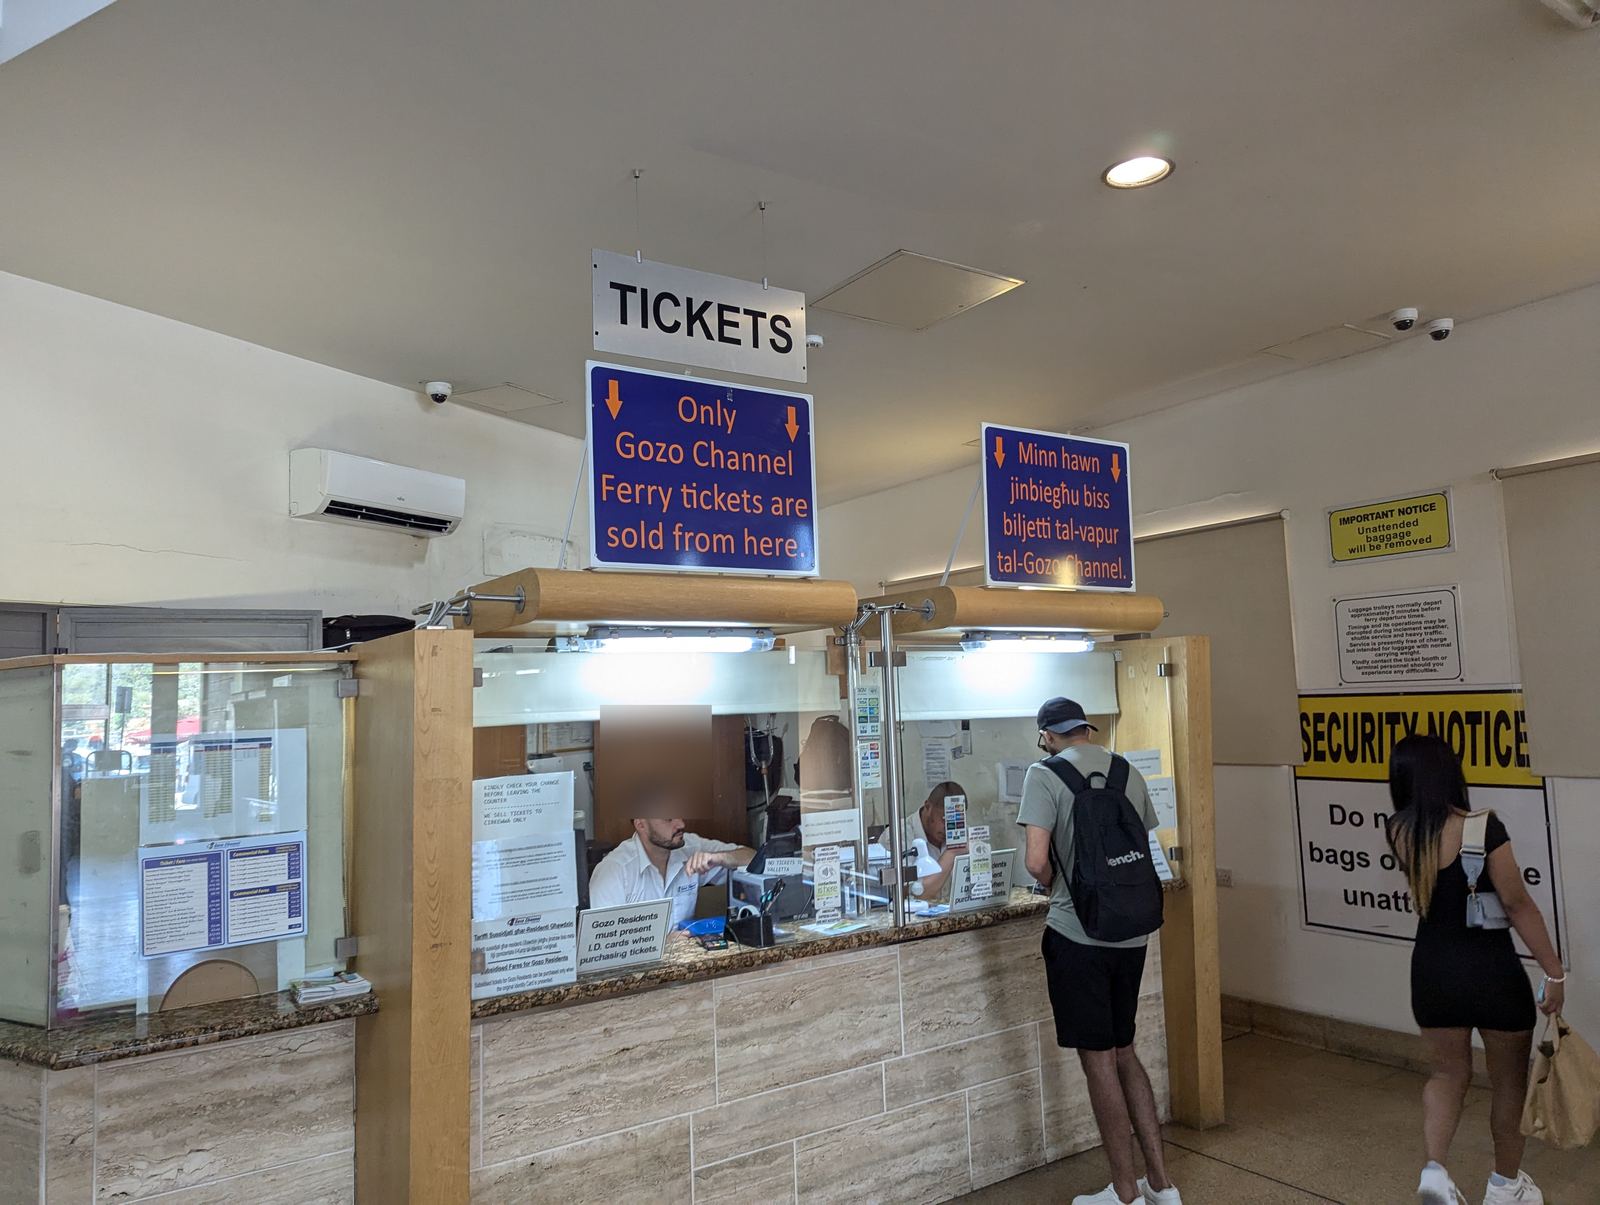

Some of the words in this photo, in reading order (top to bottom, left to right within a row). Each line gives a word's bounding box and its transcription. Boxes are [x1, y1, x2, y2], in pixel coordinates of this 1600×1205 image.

[610, 281, 792, 354] TICKETS
[678, 396, 736, 434] Only
[616, 431, 684, 464] Gozo
[693, 440, 792, 476] Channel
[1018, 442, 1057, 468] Minn
[1062, 446, 1100, 474] hawn
[601, 474, 672, 512] Ferry
[680, 482, 763, 514] tickets
[771, 496, 808, 518] are
[1084, 484, 1110, 509] biss
[1339, 510, 1395, 526] IMPORTANT
[1398, 502, 1436, 516] NOTICE
[1358, 518, 1418, 534] Unattended
[607, 520, 664, 550] sold
[672, 522, 735, 552] from
[744, 528, 804, 558] here.
[1003, 512, 1051, 542] biljetti
[1055, 518, 1119, 548] tal-vapur
[1366, 530, 1411, 543] baggage
[1348, 544, 1366, 554] will
[1370, 542, 1381, 551] be
[1385, 535, 1432, 550] removed
[997, 550, 1060, 575] tal-Gozo
[1066, 554, 1126, 580] Channel.
[1350, 610, 1390, 618] approximately
[1374, 604, 1394, 612] trolleys
[1300, 712, 1418, 764] SECURITY
[1329, 804, 1364, 827] Do
[1106, 850, 1144, 866] ench.
[1309, 841, 1370, 872] bags
[1380, 854, 1399, 870] o
[592, 920, 615, 929] Gozo
[618, 913, 658, 925] Residents
[595, 930, 618, 939] must
[620, 924, 652, 938] present
[588, 944, 602, 952] I.D.
[605, 939, 630, 949] cards
[632, 935, 654, 945] when
[580, 950, 627, 966] purchasing
[630, 946, 658, 956] tickets.
